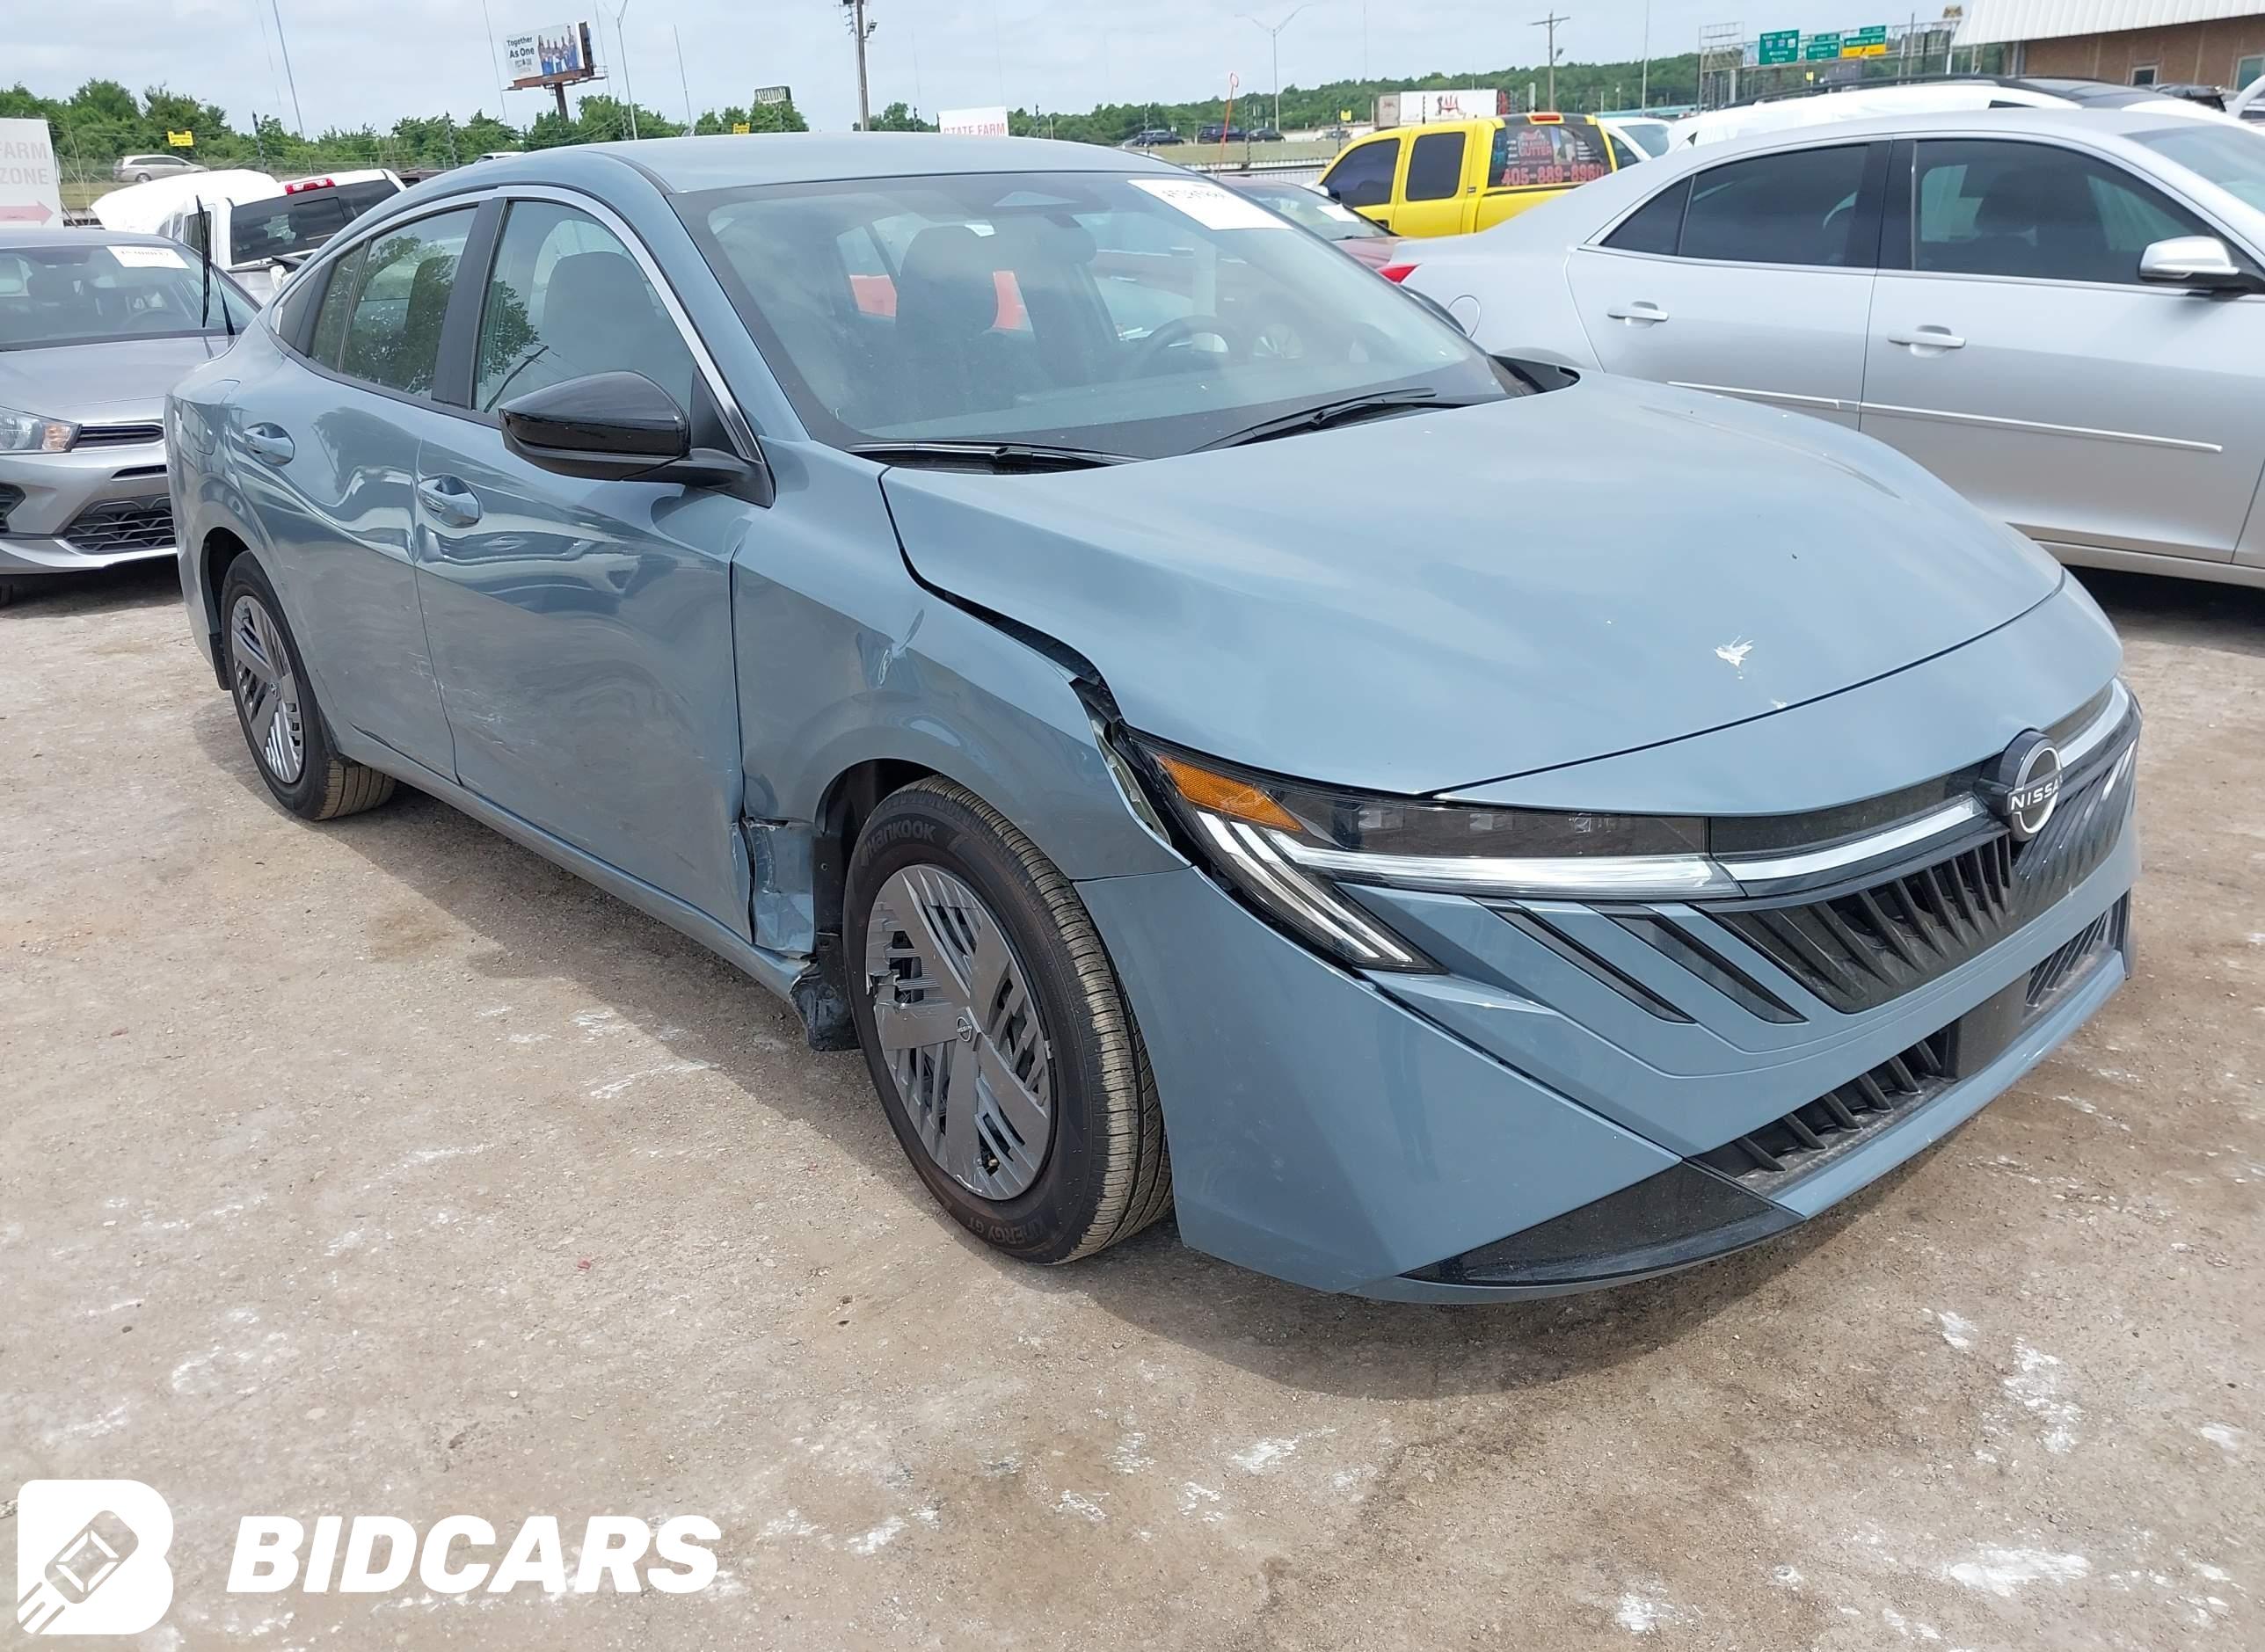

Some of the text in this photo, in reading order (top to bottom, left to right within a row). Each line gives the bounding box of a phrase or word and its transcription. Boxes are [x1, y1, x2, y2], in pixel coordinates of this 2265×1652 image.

[506, 36, 533, 47] Together
[510, 47, 535, 59] As One
[977, 123, 1005, 135] FARM
[2011, 778, 2059, 810] NISSA
